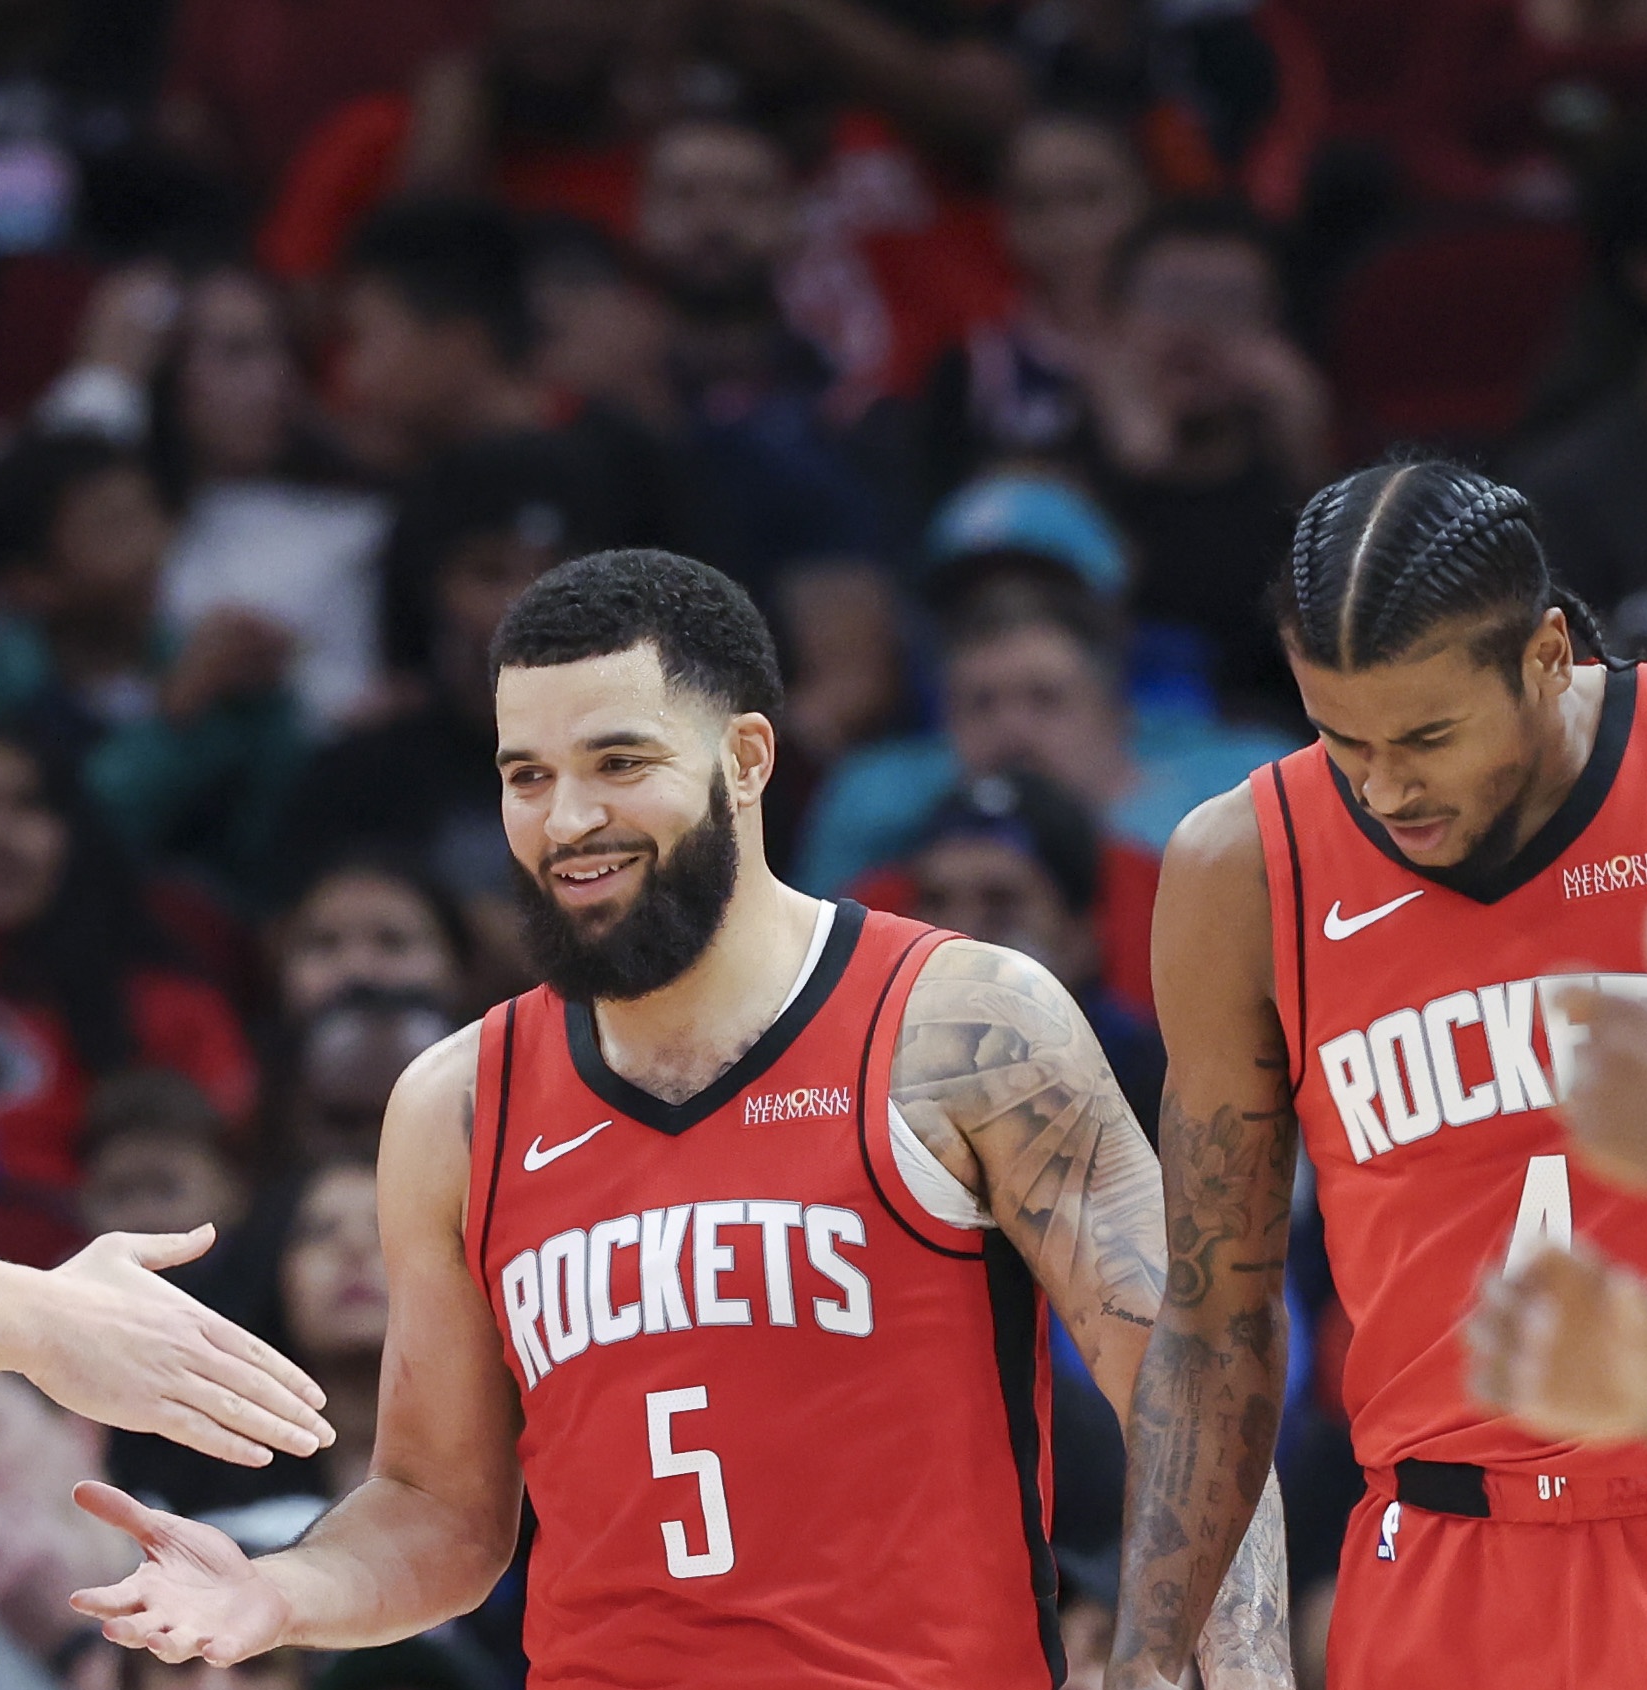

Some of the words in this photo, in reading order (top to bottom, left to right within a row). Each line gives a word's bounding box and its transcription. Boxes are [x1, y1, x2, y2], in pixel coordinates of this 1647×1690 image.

[744, 1087, 851, 1112] MEMORIAL
[744, 1100, 850, 1124] HERMANN
[501, 1199, 873, 1391] ROCKETS
[646, 1385, 735, 1579] 5
